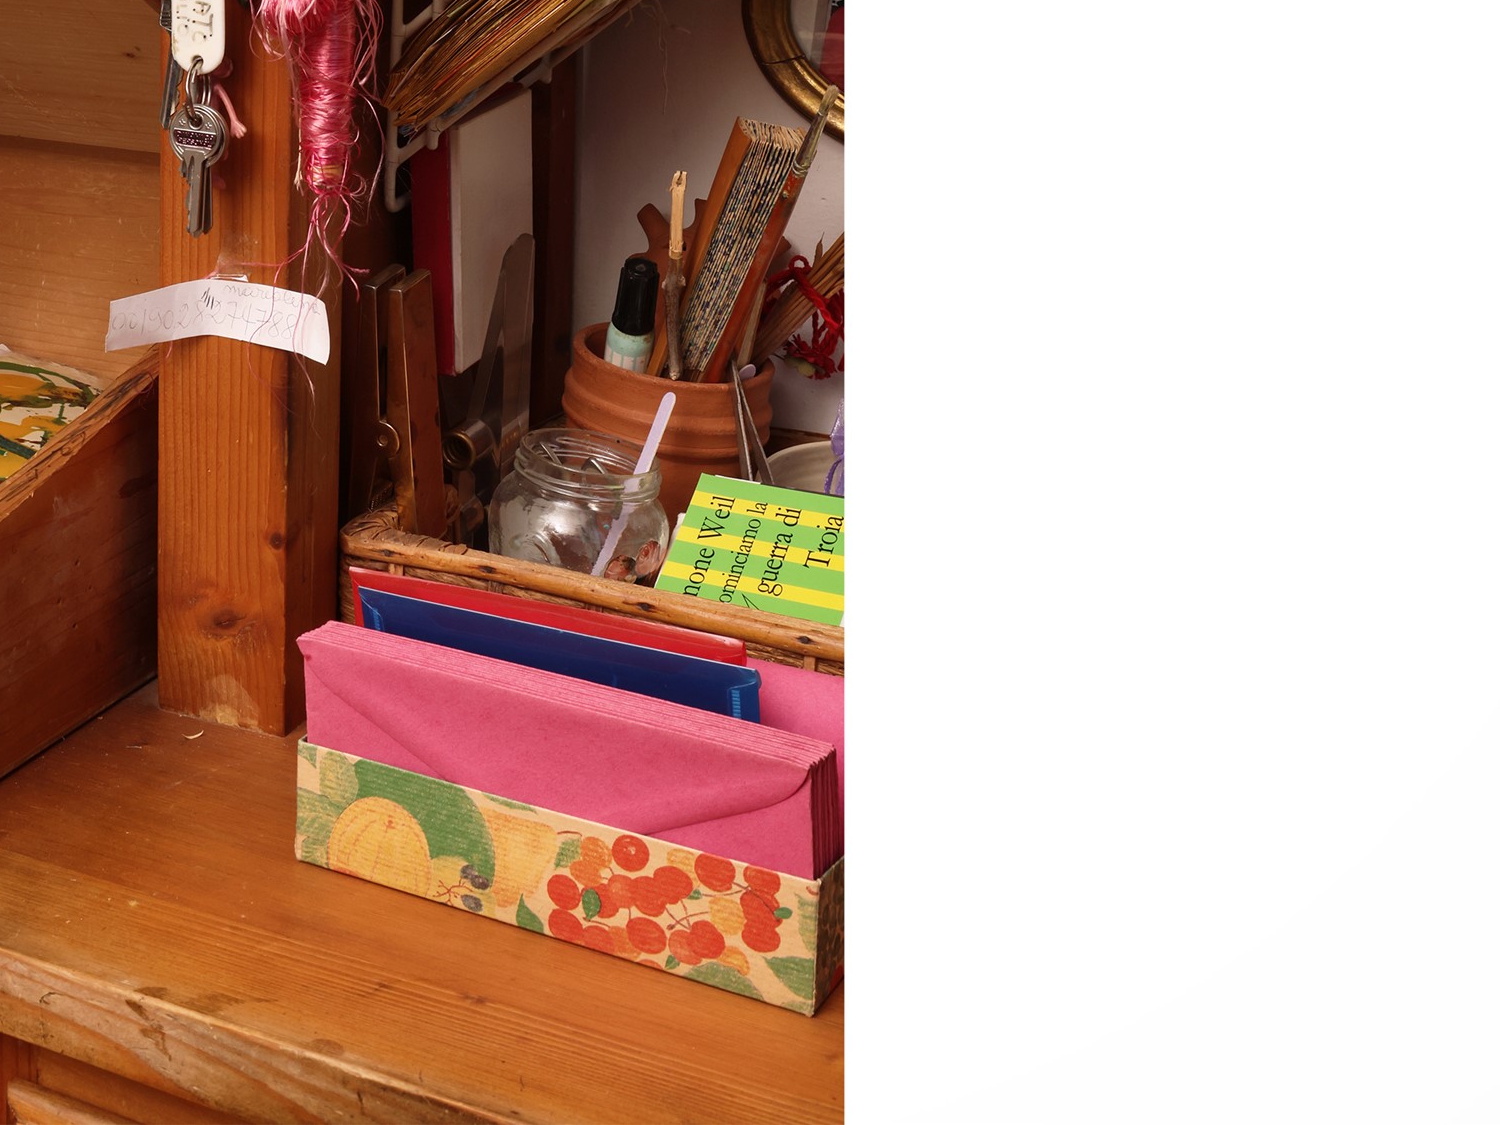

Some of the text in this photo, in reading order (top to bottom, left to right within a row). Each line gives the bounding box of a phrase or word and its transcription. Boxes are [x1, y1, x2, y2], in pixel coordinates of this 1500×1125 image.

[697, 496, 736, 540] Weil
[746, 502, 769, 516] la
[757, 507, 802, 597] guerra di
[802, 515, 844, 569] Troia
